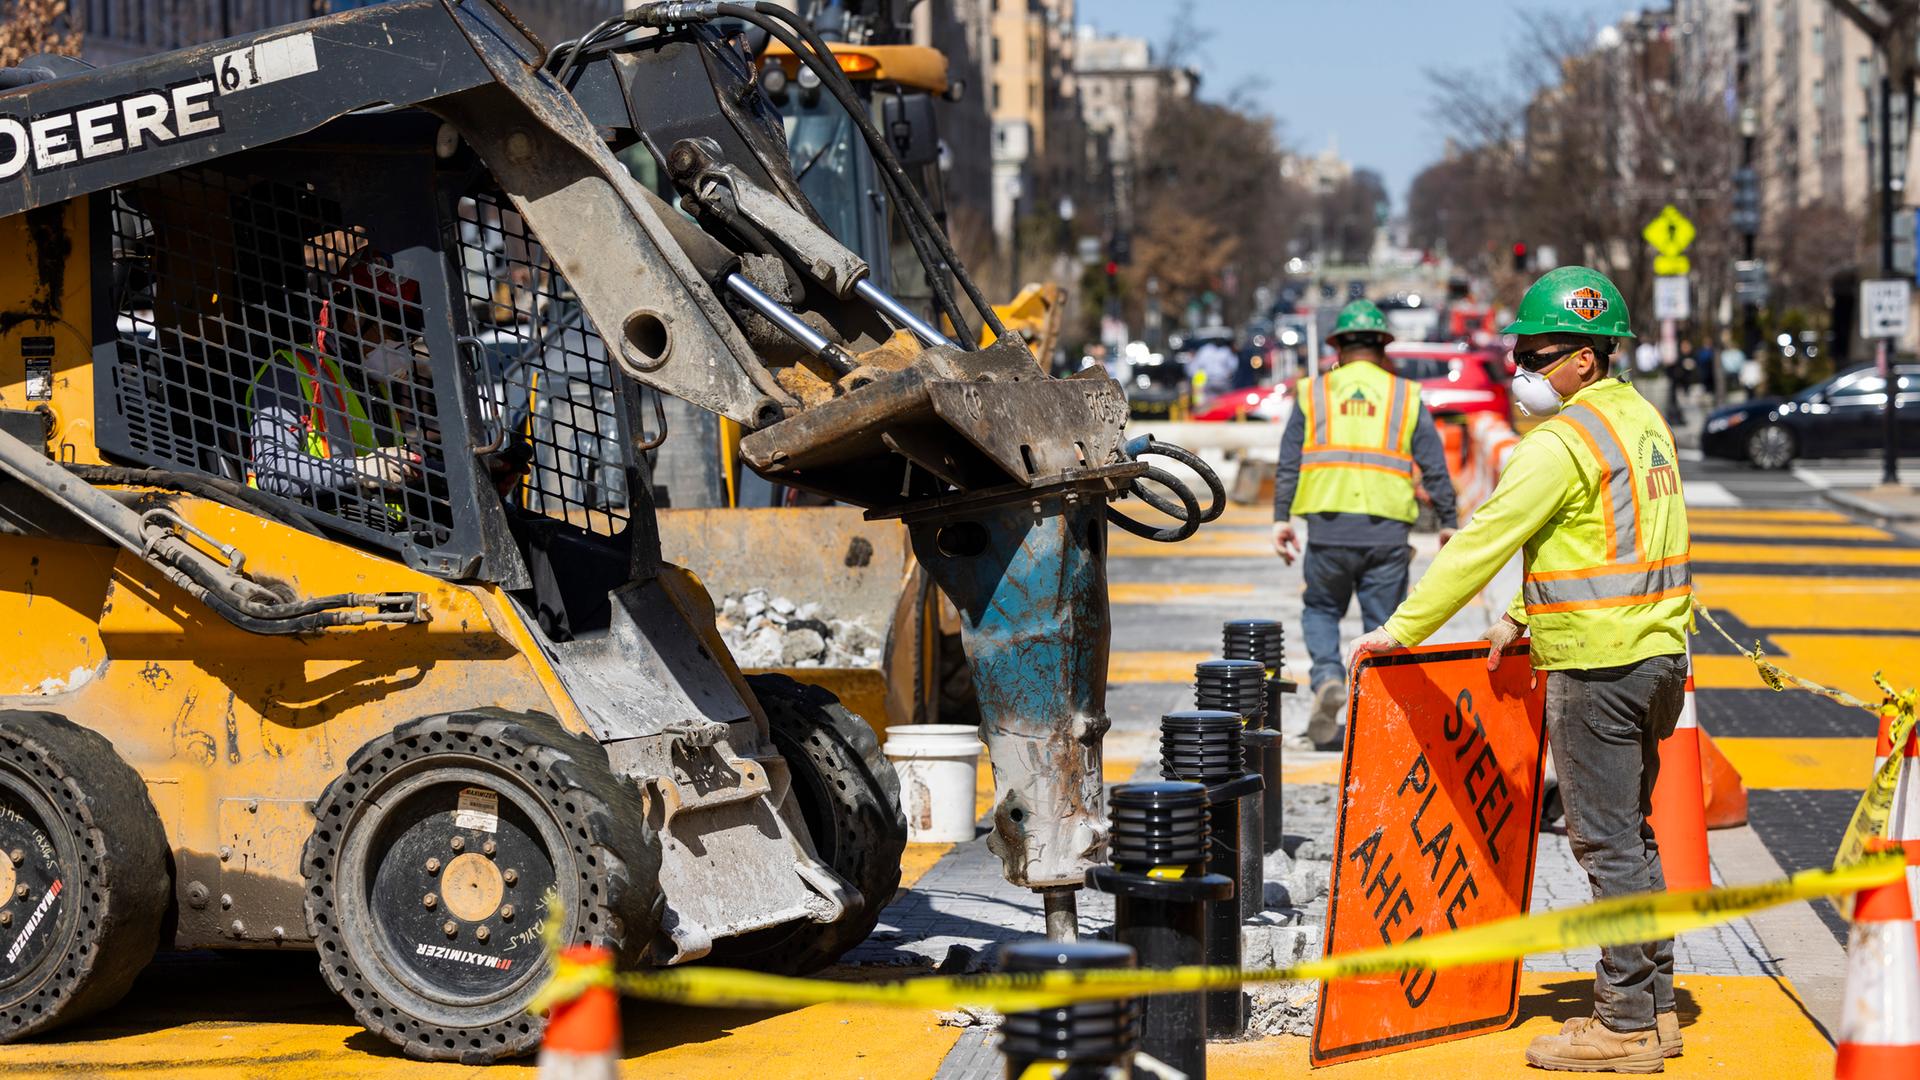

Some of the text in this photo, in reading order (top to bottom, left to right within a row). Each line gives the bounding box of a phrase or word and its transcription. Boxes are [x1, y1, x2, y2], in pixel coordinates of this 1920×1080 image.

[220, 46, 263, 91] 61
[0, 80, 221, 179] DEERE
[1443, 688, 1514, 865] STEEL
[1397, 751, 1479, 934] PLATE
[6, 889, 56, 964] MAXIMIZER
[416, 943, 501, 969] MAXIMIZER
